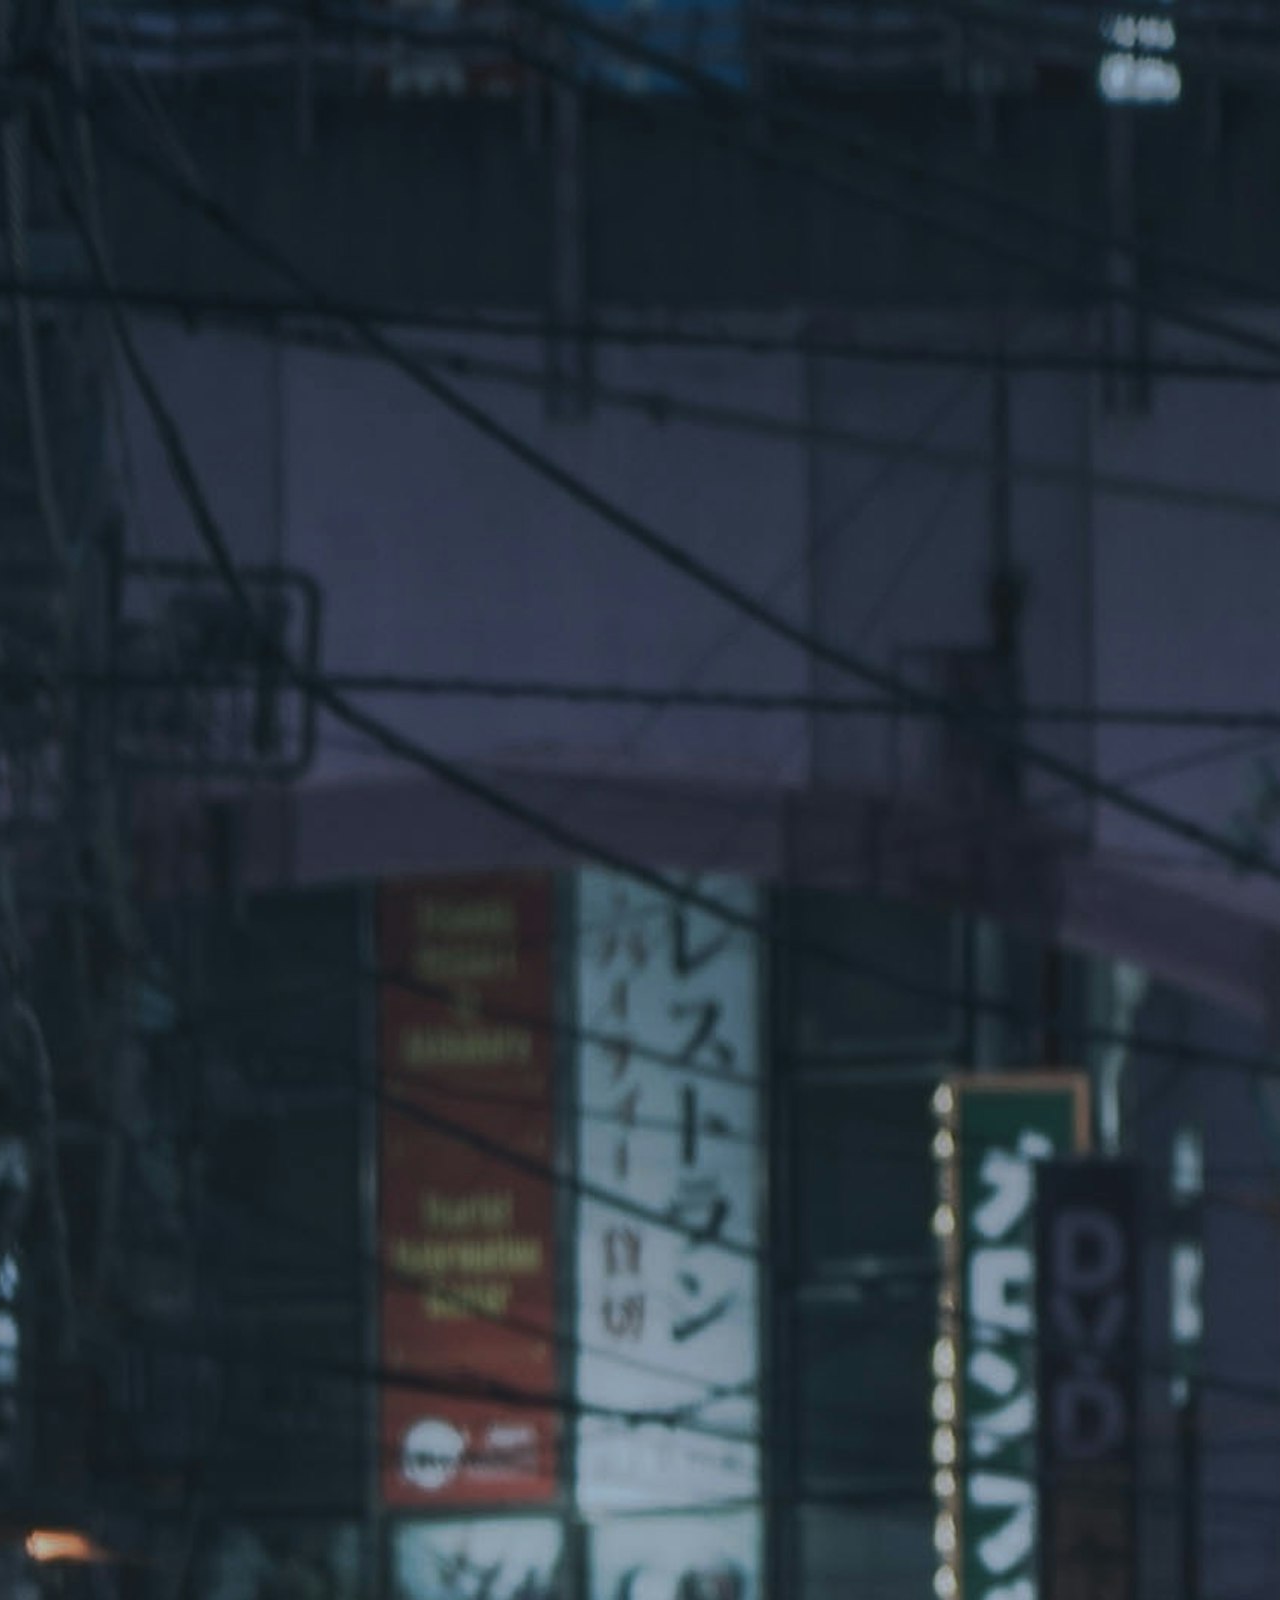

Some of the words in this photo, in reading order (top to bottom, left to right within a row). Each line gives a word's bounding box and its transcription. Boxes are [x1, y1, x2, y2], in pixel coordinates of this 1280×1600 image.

[670, 902, 736, 1342] レストラン
[1050, 1210, 1124, 1458] DVD
